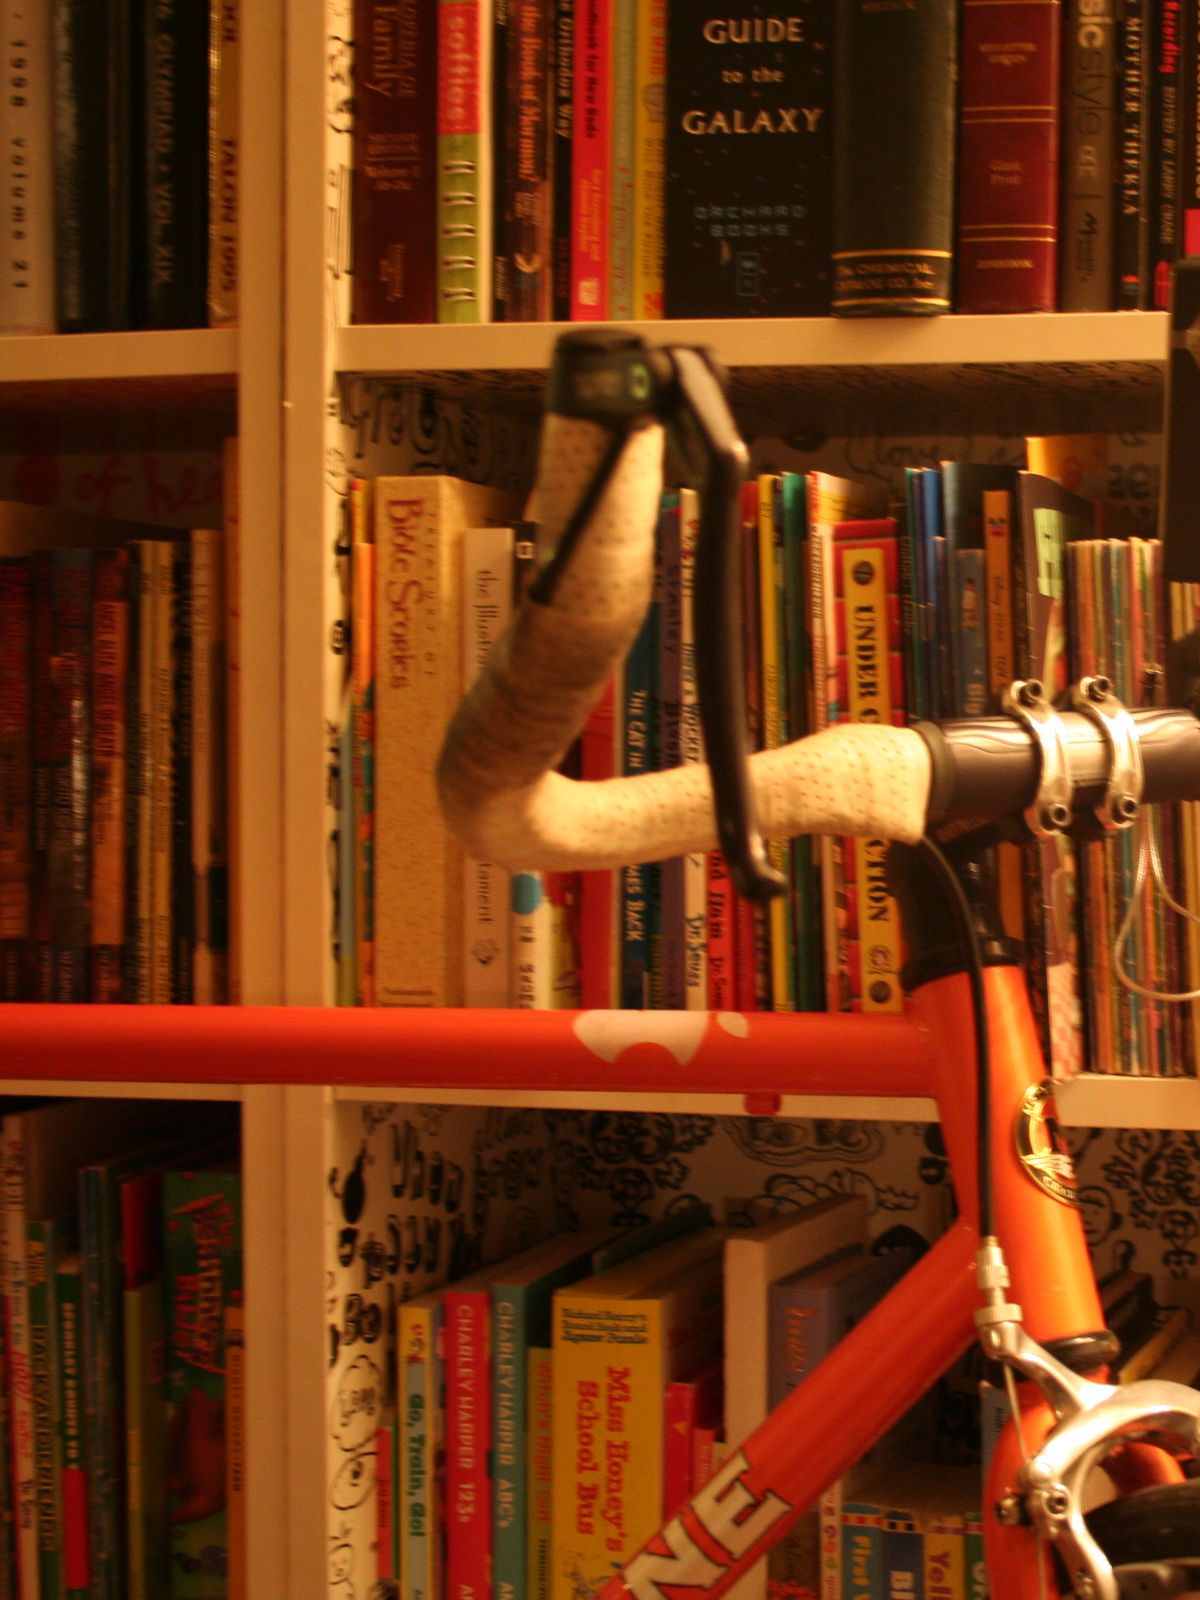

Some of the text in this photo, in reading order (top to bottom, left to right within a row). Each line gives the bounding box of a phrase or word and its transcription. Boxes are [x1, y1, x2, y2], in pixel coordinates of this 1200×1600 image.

[702, 18, 804, 44] GUIDE
[722, 67, 784, 83] to the
[681, 108, 823, 135] GALAXY
[1123, 17, 1142, 216] MOTHER THEKLA
[694, 204, 806, 219] ORCHARD
[710, 224, 790, 237] BOOKS
[386, 499, 426, 689] Bible Stories
[474, 571, 499, 598] the
[853, 604, 881, 698] UNDER
[624, 690, 650, 942] THE CAT IN BACK
[685, 914, 705, 939] Dr.
[687, 941, 709, 988] Seuss
[456, 1304, 475, 1391] CHARLEY
[457, 1396, 475, 1469] HARPER
[496, 1301, 516, 1529] CHARLEY HARPER ABC's
[406, 1393, 426, 1537] Go, Train, Go!
[576, 1380, 600, 1535] School Bus
[600, 1366, 632, 1553] Miss Honey's
[851, 1535, 873, 1587] First
